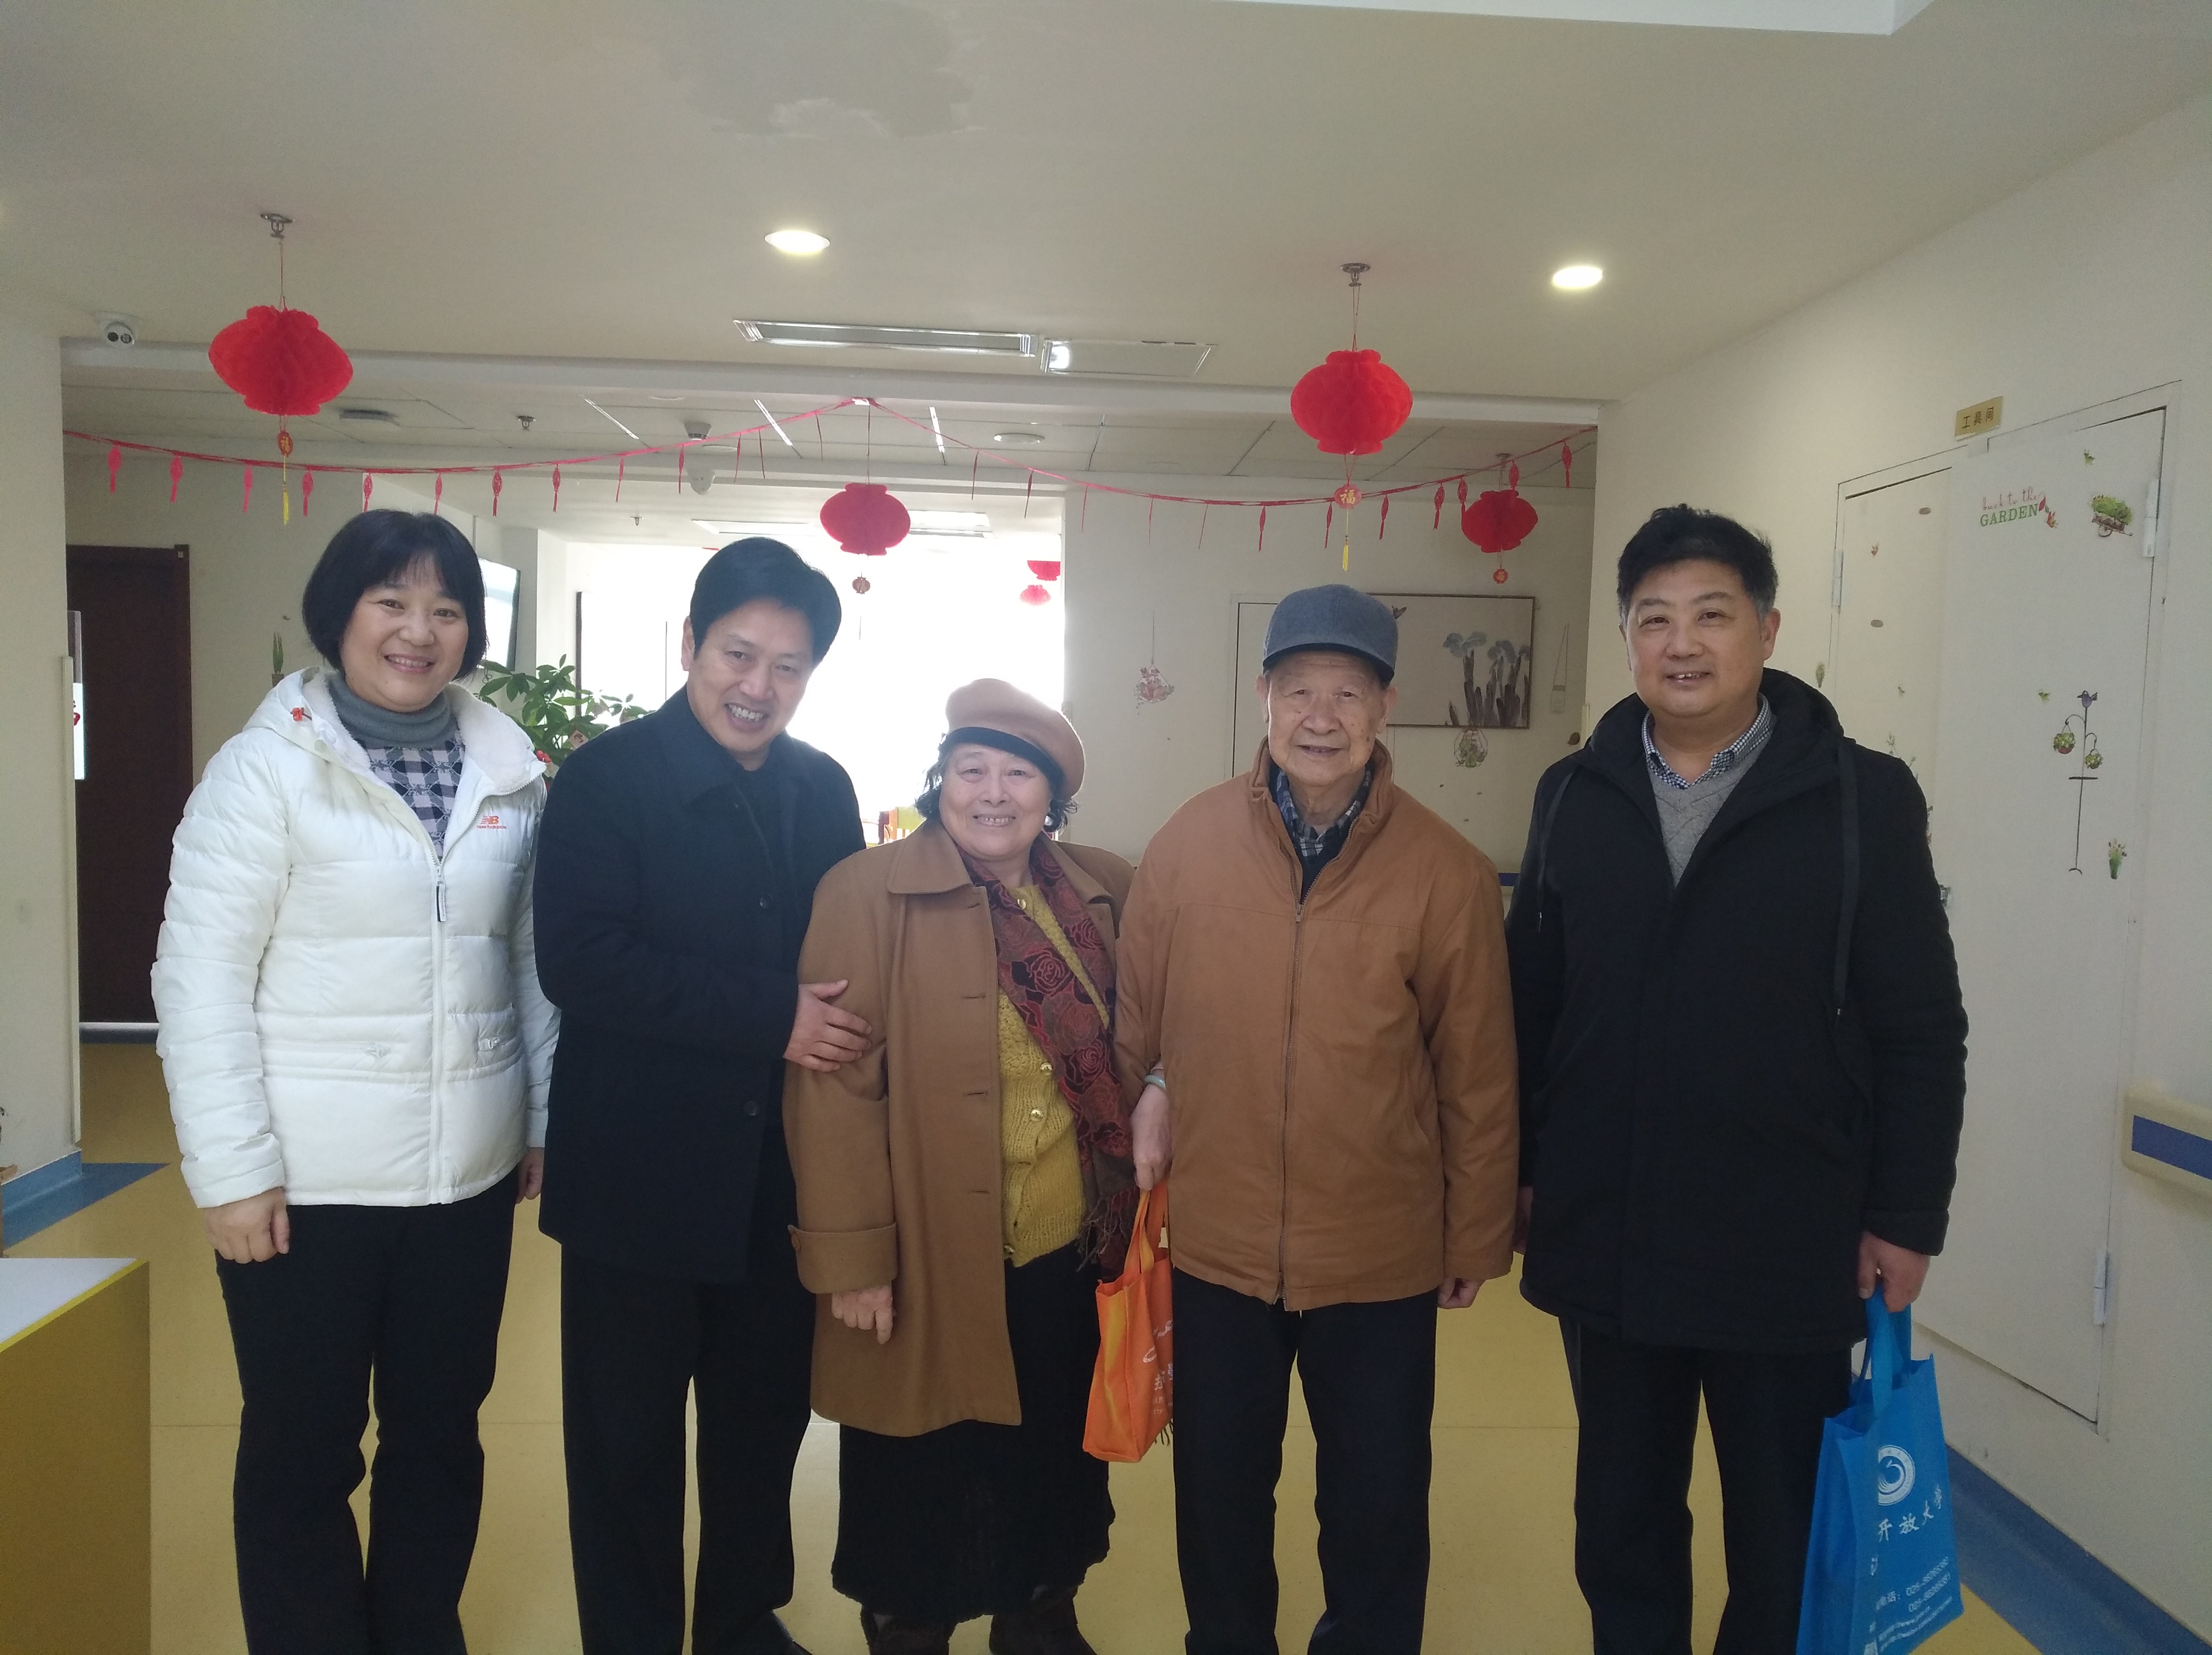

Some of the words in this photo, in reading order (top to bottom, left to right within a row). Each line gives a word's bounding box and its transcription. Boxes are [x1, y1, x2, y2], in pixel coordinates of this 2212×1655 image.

[1962, 407, 1994, 428] 工具间
[1340, 489, 1355, 504] 福
[2007, 492, 2017, 505] to
[2022, 486, 2037, 502] the
[1980, 503, 2038, 526] GARDEN
